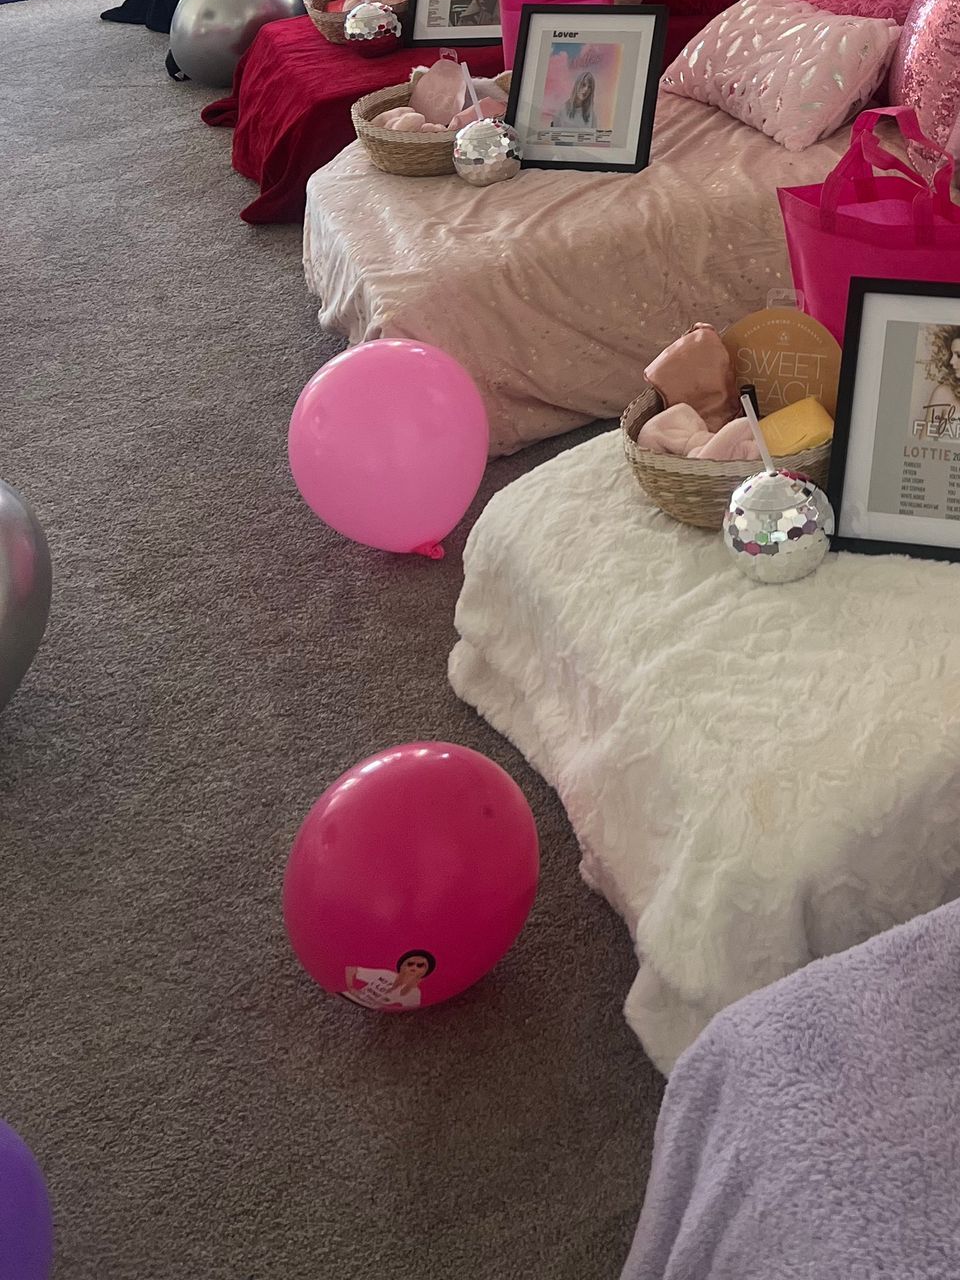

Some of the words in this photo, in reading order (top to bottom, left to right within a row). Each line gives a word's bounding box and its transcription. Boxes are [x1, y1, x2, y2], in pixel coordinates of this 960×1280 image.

[553, 30, 579, 38] Lover
[737, 347, 828, 379] SWEET
[903, 445, 951, 462] LOTTIE
